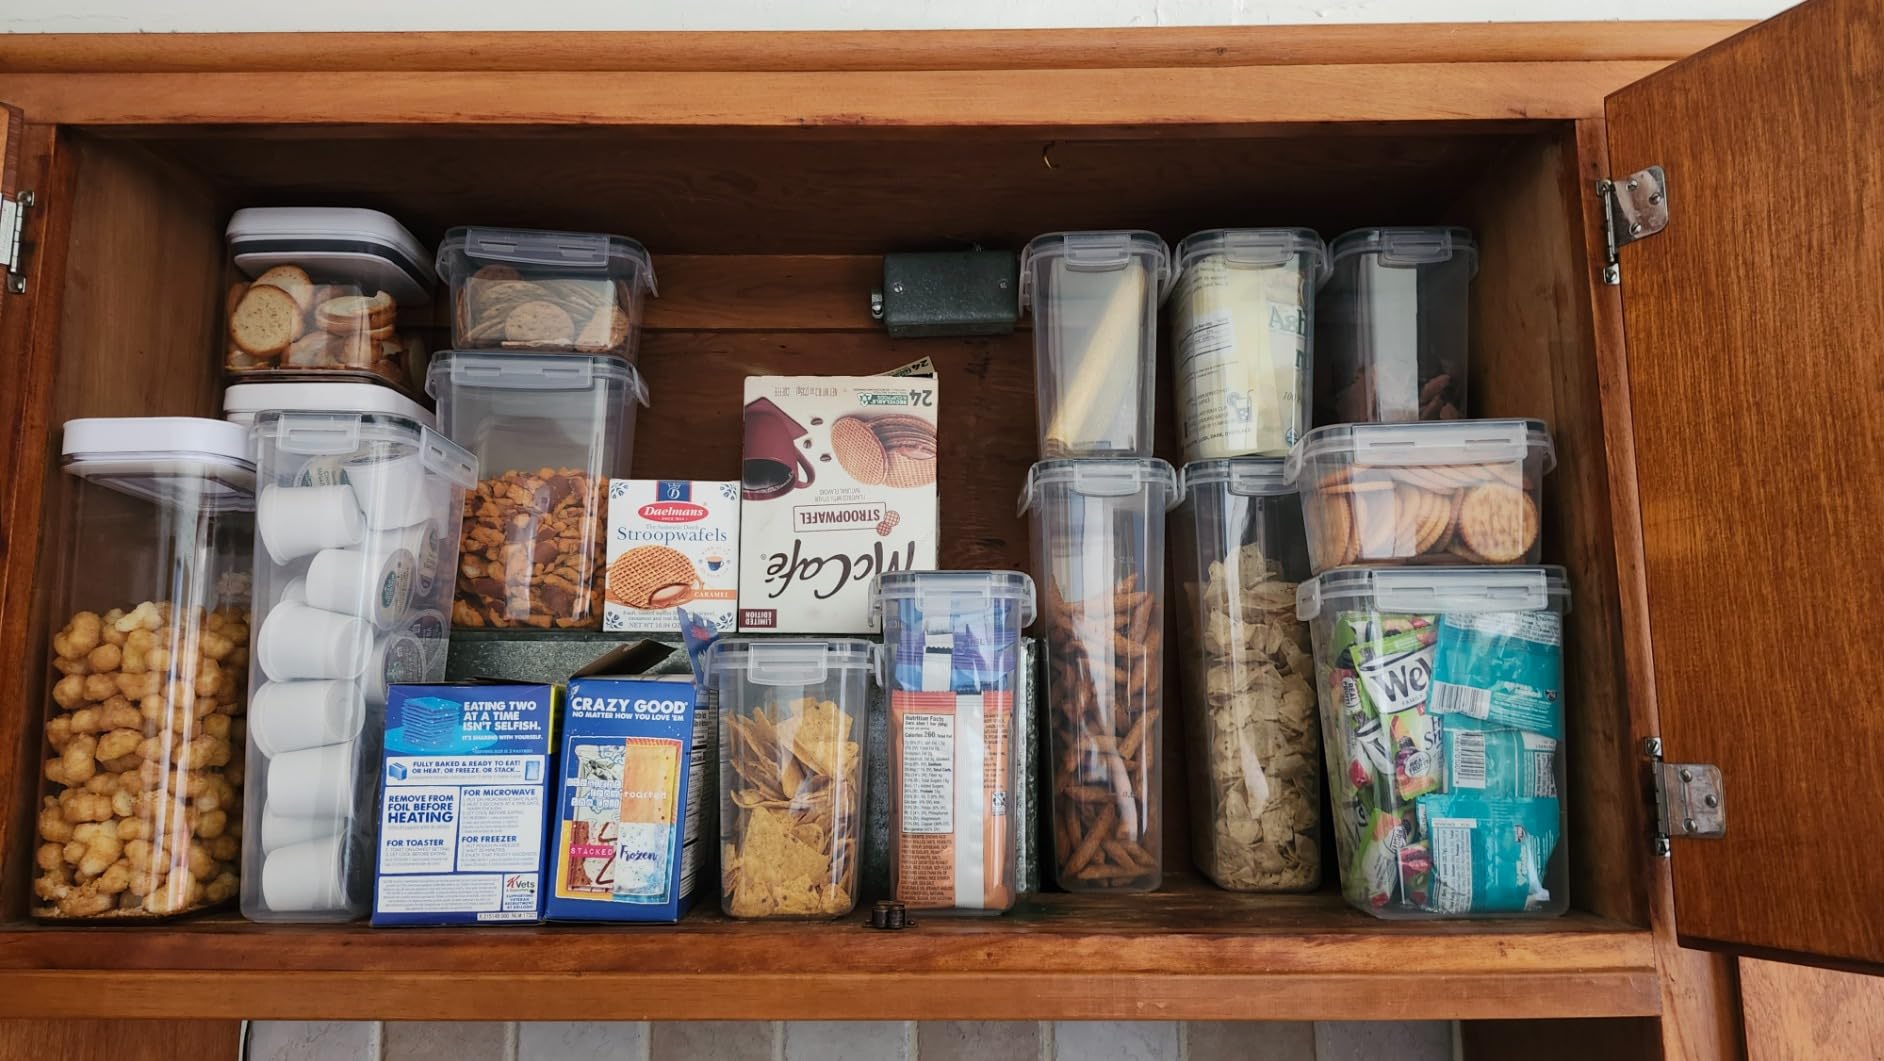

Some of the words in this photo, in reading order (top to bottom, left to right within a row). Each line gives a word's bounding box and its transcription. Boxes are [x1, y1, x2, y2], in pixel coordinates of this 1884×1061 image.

[910, 389, 932, 407] 24
[644, 506, 704, 516] Daelmans
[800, 509, 880, 525] STROOPWAFEL
[617, 527, 728, 546] Stroopwafels
[765, 538, 916, 600] McCafé
[464, 701, 506, 711] EATING
[509, 701, 537, 710] TWO
[571, 697, 630, 712] CRAZY
[464, 711, 478, 720] AT
[480, 711, 490, 720] A
[493, 711, 520, 720] TIME
[463, 721, 491, 731] ISN'T
[494, 721, 542, 731] SELFISH.
[388, 803, 410, 811] FOIL
[414, 803, 453, 811] BEFORE
[388, 812, 453, 823] HEATING
[570, 847, 613, 855] STACKED
[620, 844, 657, 861] Frozen
